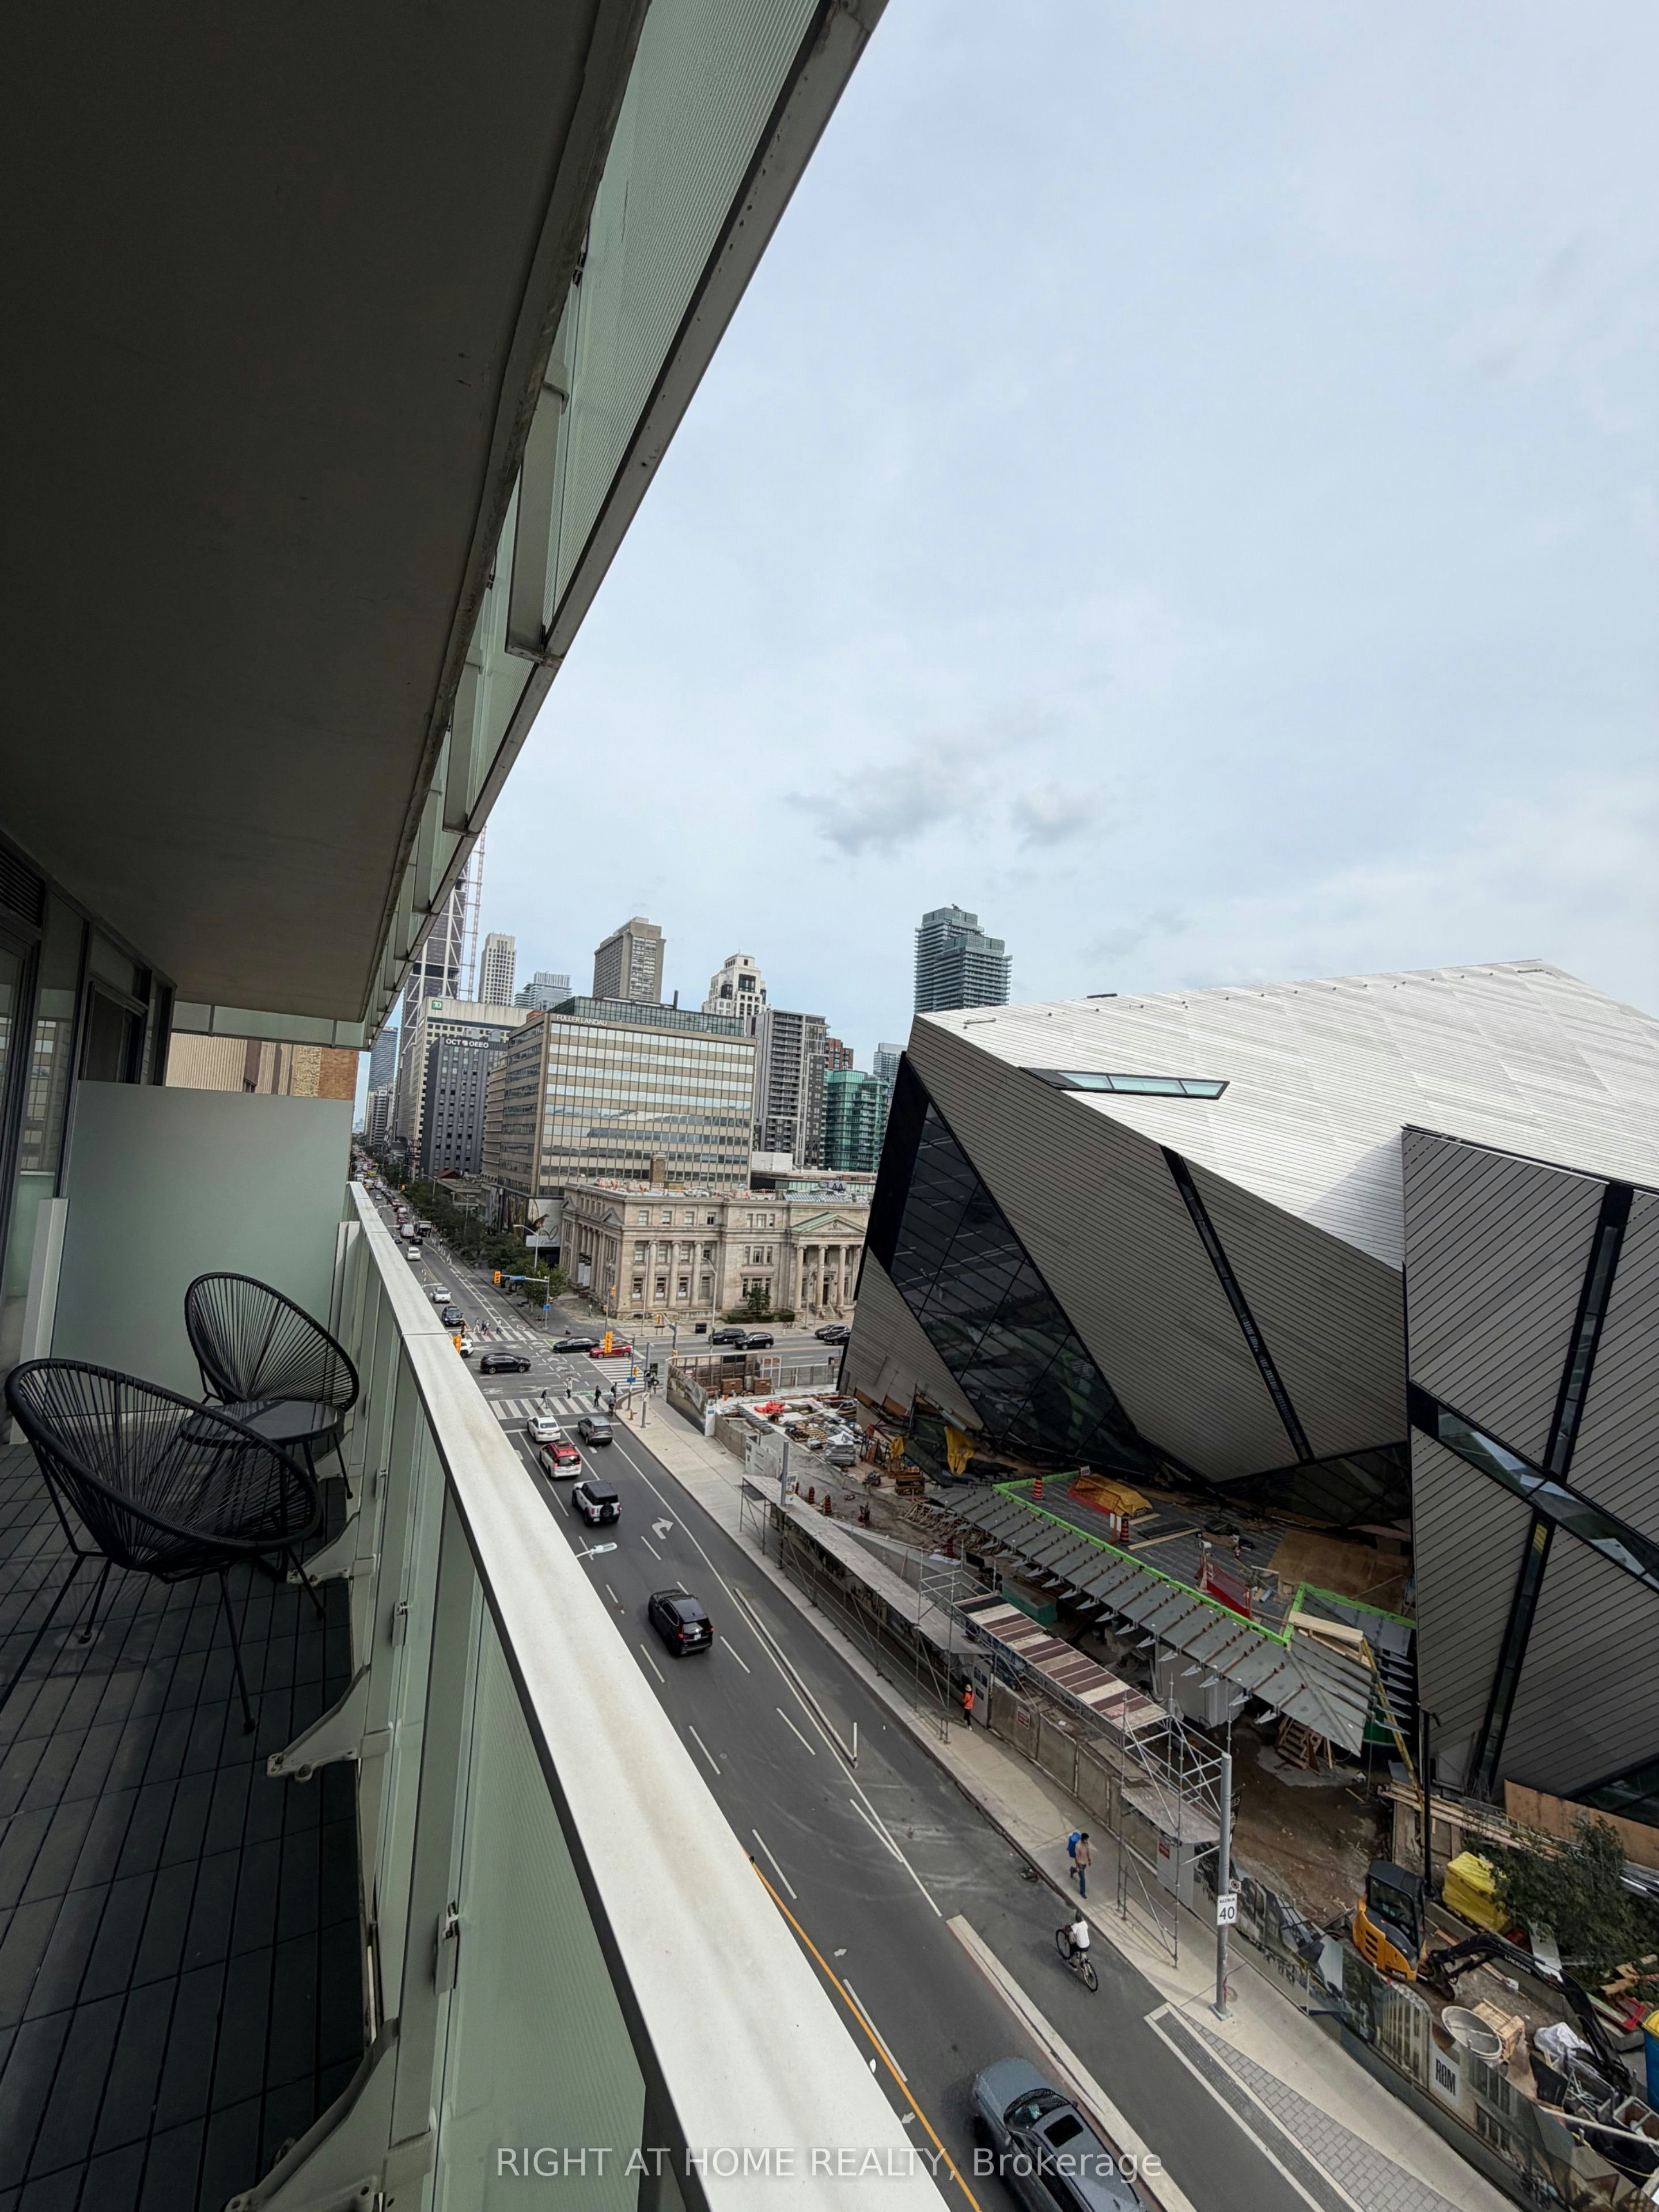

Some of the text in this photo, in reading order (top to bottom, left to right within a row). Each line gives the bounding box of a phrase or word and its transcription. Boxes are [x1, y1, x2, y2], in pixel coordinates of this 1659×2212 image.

[556, 1014, 608, 1026] FULLER LANDAU
[1219, 1906, 1234, 1920] 40
[1435, 2058, 1456, 2096] ROM
